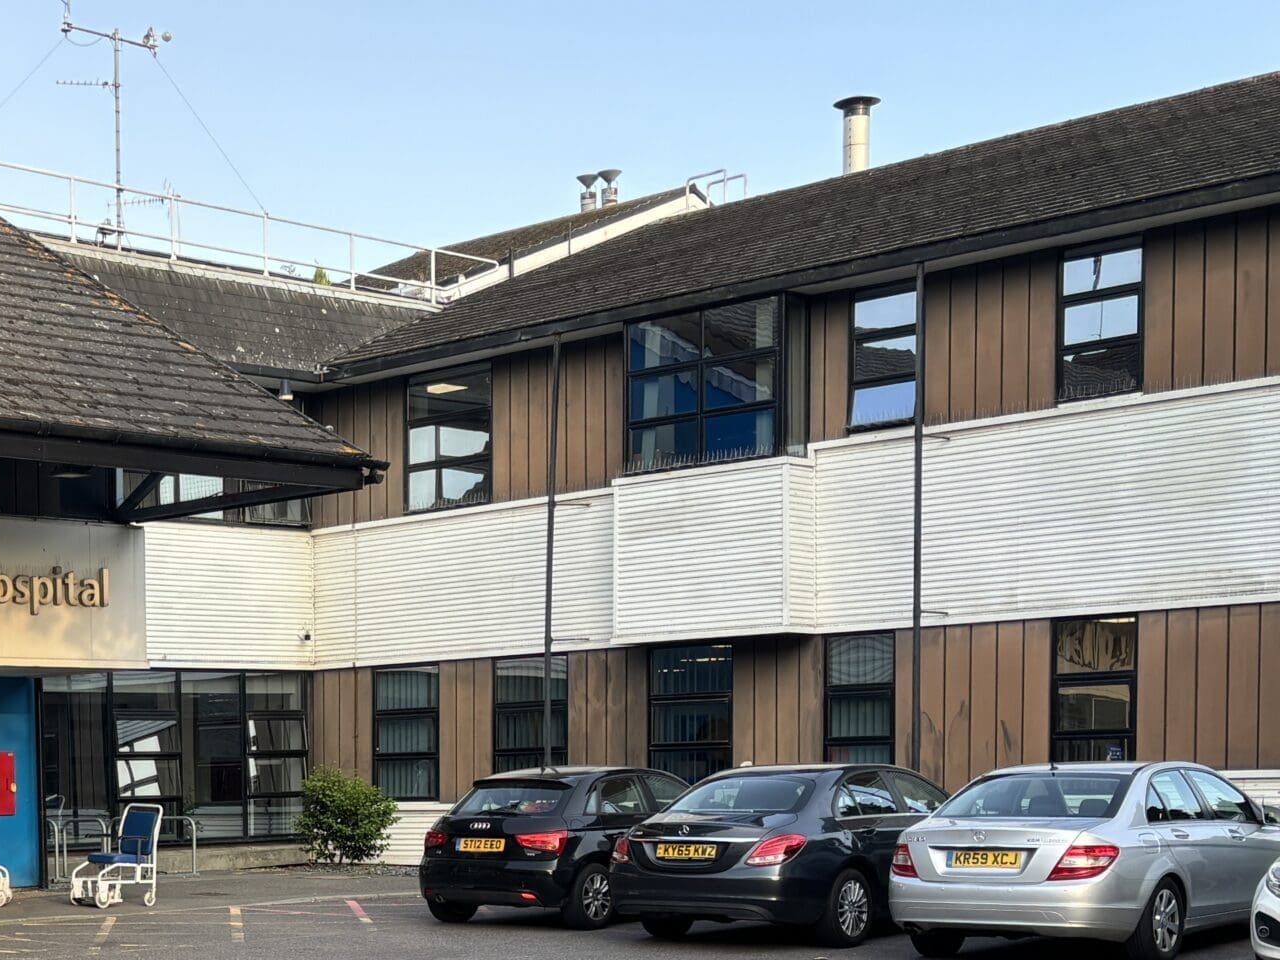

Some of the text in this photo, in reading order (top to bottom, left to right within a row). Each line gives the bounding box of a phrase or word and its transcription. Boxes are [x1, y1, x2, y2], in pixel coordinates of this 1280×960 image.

[463, 839, 482, 849] ST12
[663, 844, 715, 856] KY65 KWZ
[954, 852, 1018, 865] KR59 XCJ
